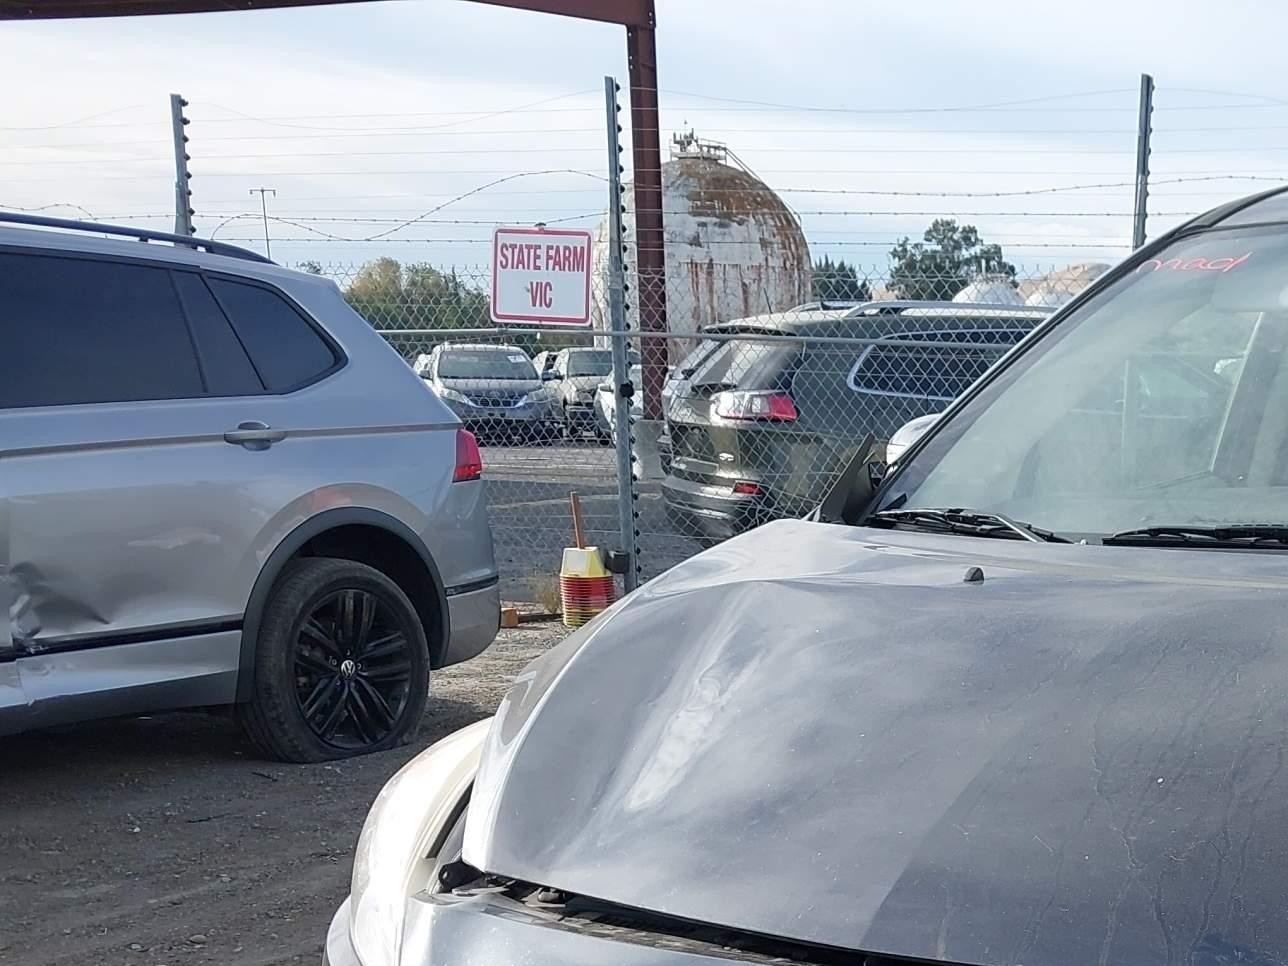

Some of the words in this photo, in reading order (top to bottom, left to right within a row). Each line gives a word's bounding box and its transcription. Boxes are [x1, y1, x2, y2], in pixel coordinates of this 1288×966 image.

[500, 243, 541, 270] STATE
[545, 245, 584, 272] FARM
[529, 281, 552, 308] VIC
